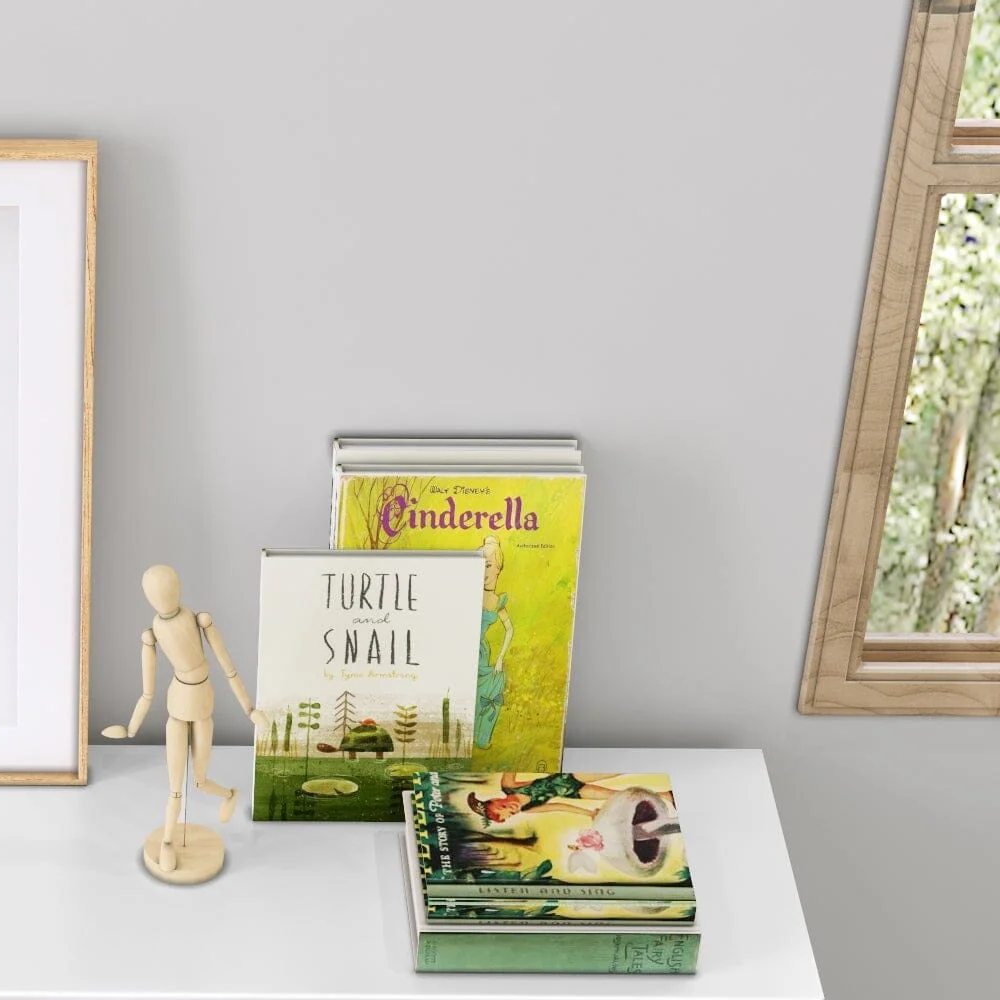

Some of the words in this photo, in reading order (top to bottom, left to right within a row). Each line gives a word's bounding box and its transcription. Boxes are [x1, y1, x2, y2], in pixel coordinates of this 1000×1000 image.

[381, 496, 539, 537] Cinderella
[321, 572, 417, 611] TURTLE
[352, 612, 391, 624] and
[323, 628, 420, 666] SNAIL
[323, 668, 334, 680] by
[429, 787, 443, 812] Peter
[436, 813, 445, 824] OF
[437, 826, 449, 852] STORY
[440, 854, 452, 876] THE
[479, 887, 529, 895] LISTEN
